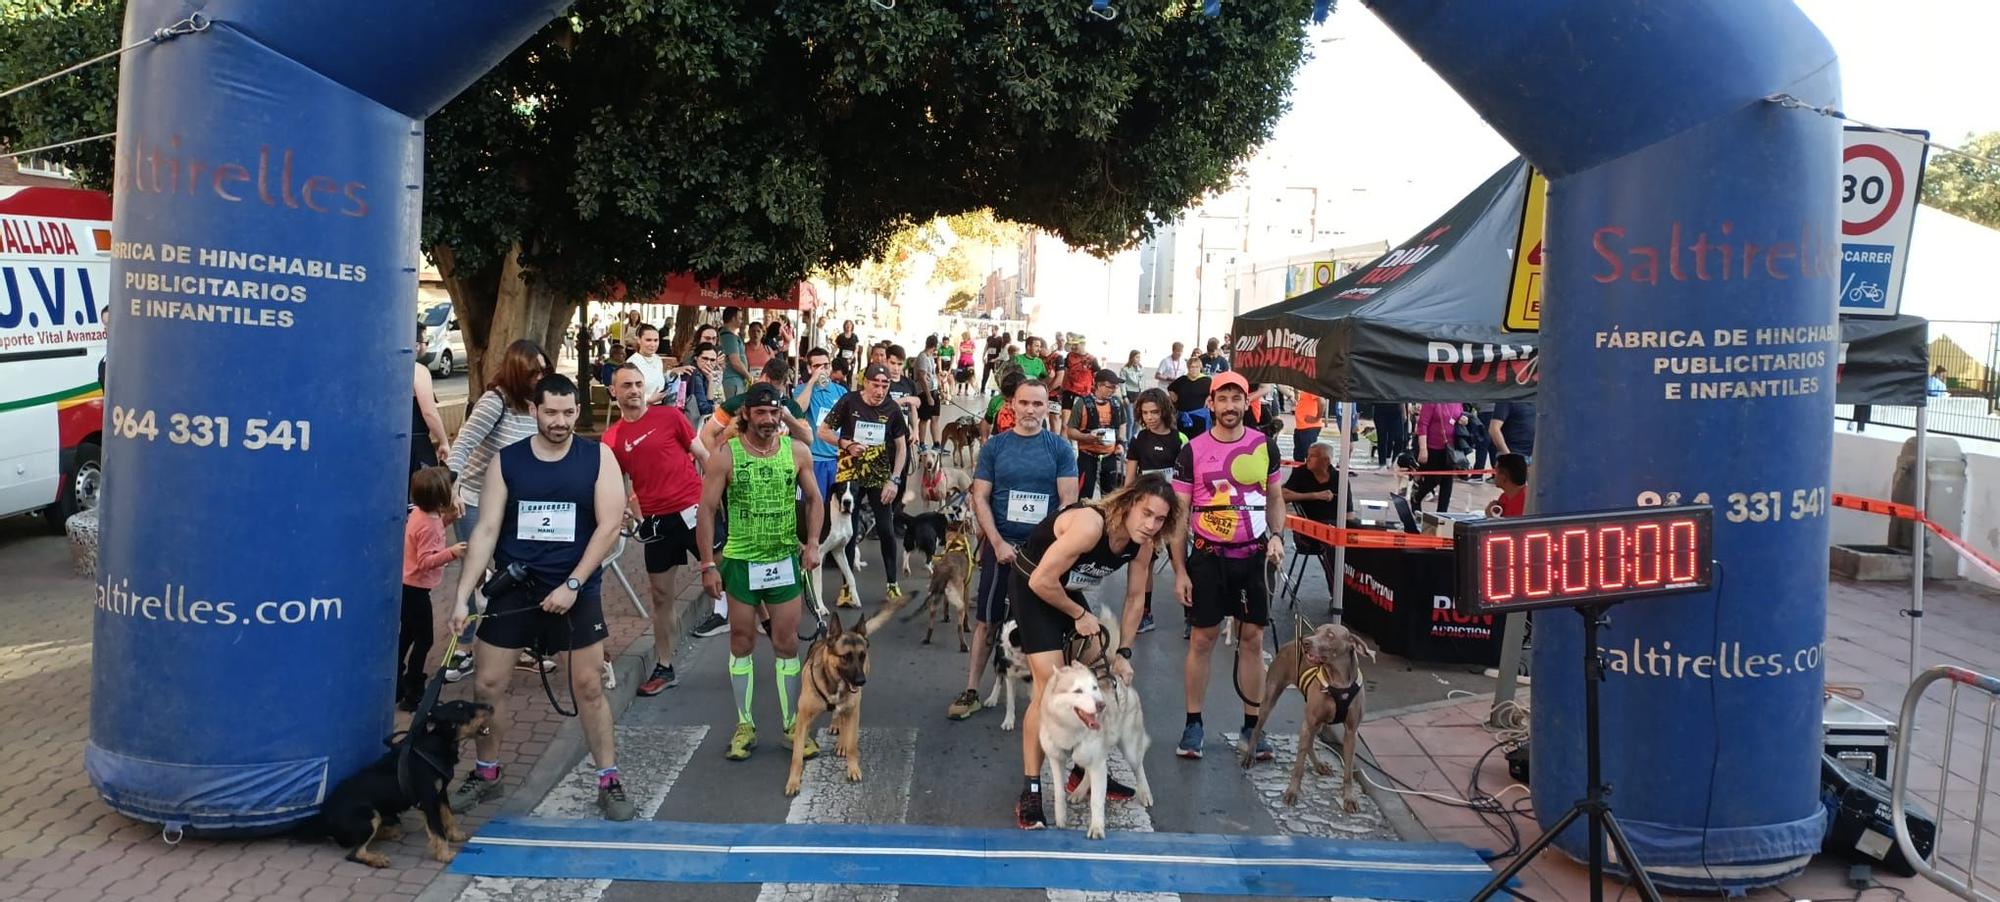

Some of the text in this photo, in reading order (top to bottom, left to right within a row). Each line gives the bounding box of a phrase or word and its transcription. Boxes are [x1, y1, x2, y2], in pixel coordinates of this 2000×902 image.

[1843, 174, 1884, 205] 30
[0, 219, 79, 256] ALLADA
[161, 244, 191, 265] DE
[199, 248, 367, 283] HINCHABLES
[126, 272, 307, 304] PUBLICITARIOS
[131, 299, 294, 328] E INFANTILES
[37, 331, 63, 344] Vital
[1595, 325, 1705, 349] FÁBRICA
[1714, 330, 1747, 347] DE
[1654, 351, 1825, 375] PUBLICITARIOS
[1665, 377, 1819, 400] E INFANTILES
[112, 406, 311, 451] 964 331 541
[1022, 504, 1035, 512] 63
[1726, 491, 1782, 523] 331
[1790, 487, 1825, 520] 541
[541, 517, 551, 527] 2
[765, 567, 778, 577] 24
[1486, 521, 1696, 601] 00:00:00
[1430, 625, 1491, 640] ADDICTION
